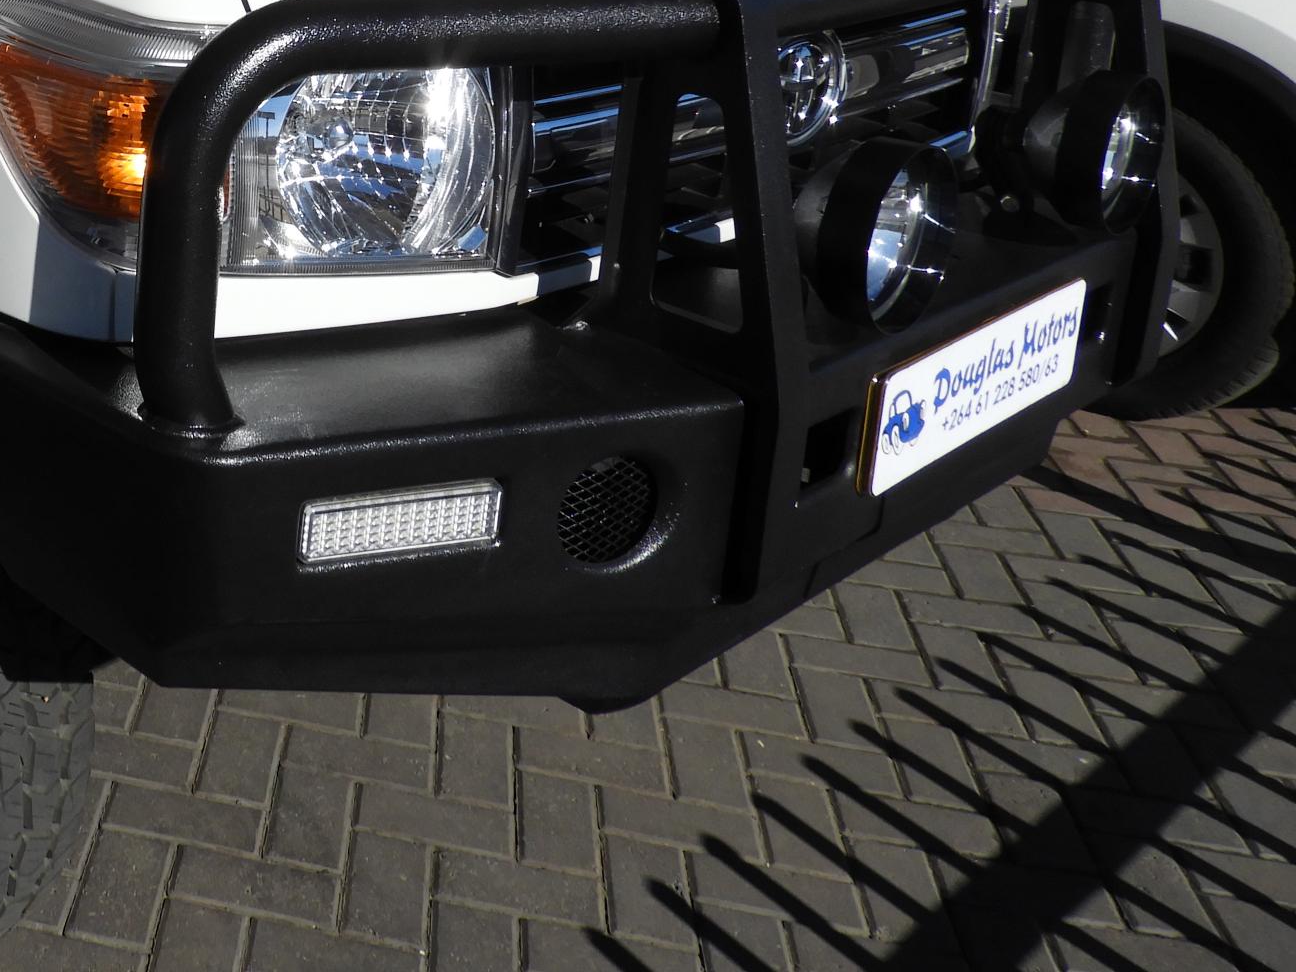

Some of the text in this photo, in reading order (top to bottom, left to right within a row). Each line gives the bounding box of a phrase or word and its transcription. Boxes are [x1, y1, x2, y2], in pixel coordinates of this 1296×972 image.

[933, 306, 1079, 414] Douglas Motors
[941, 353, 1059, 432] +264 61 228 580/63
